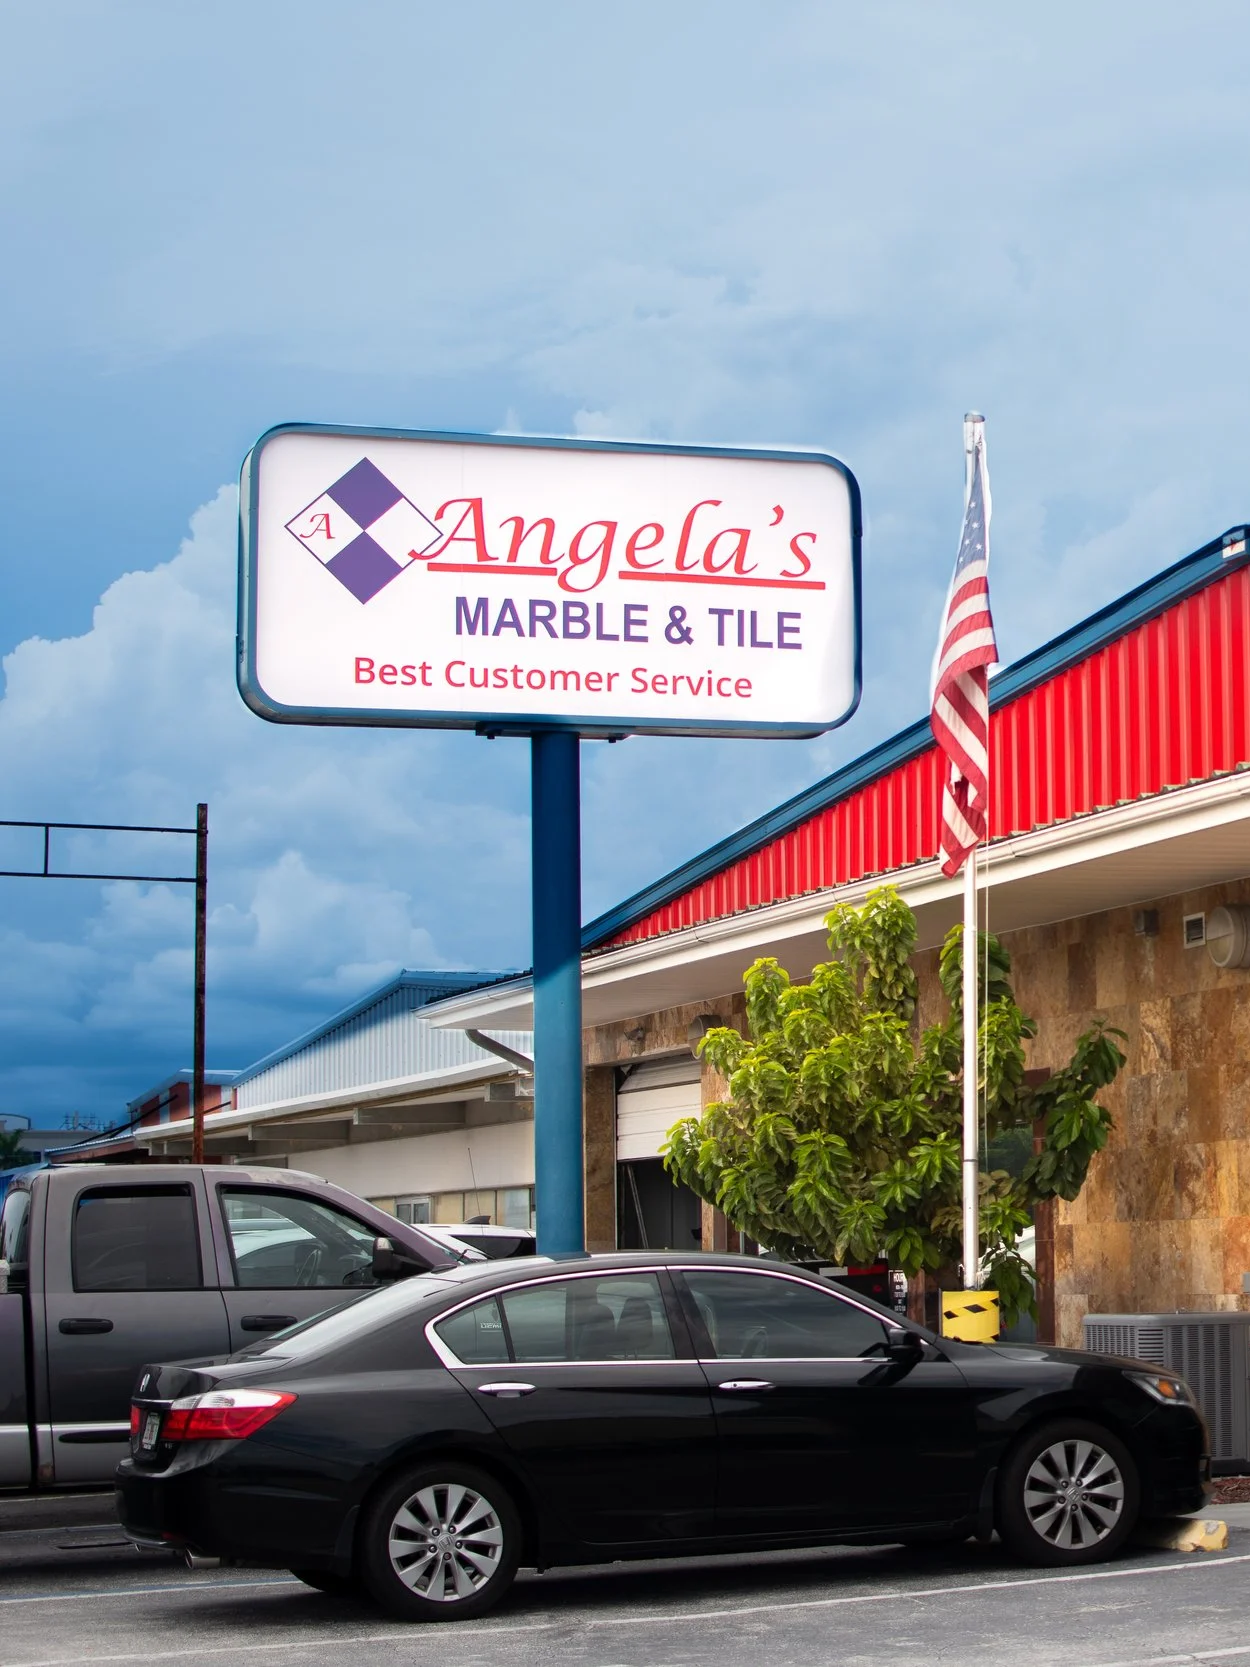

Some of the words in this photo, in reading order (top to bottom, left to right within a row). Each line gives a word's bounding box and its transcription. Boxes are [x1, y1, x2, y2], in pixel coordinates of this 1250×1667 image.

[300, 513, 336, 541] A
[408, 498, 818, 593] Angela's
[455, 597, 650, 643] MARBLE
[664, 605, 695, 645] &
[708, 608, 803, 650] TILE
[353, 656, 433, 688] Best
[444, 660, 621, 694] Customer
[630, 667, 753, 699] Service
